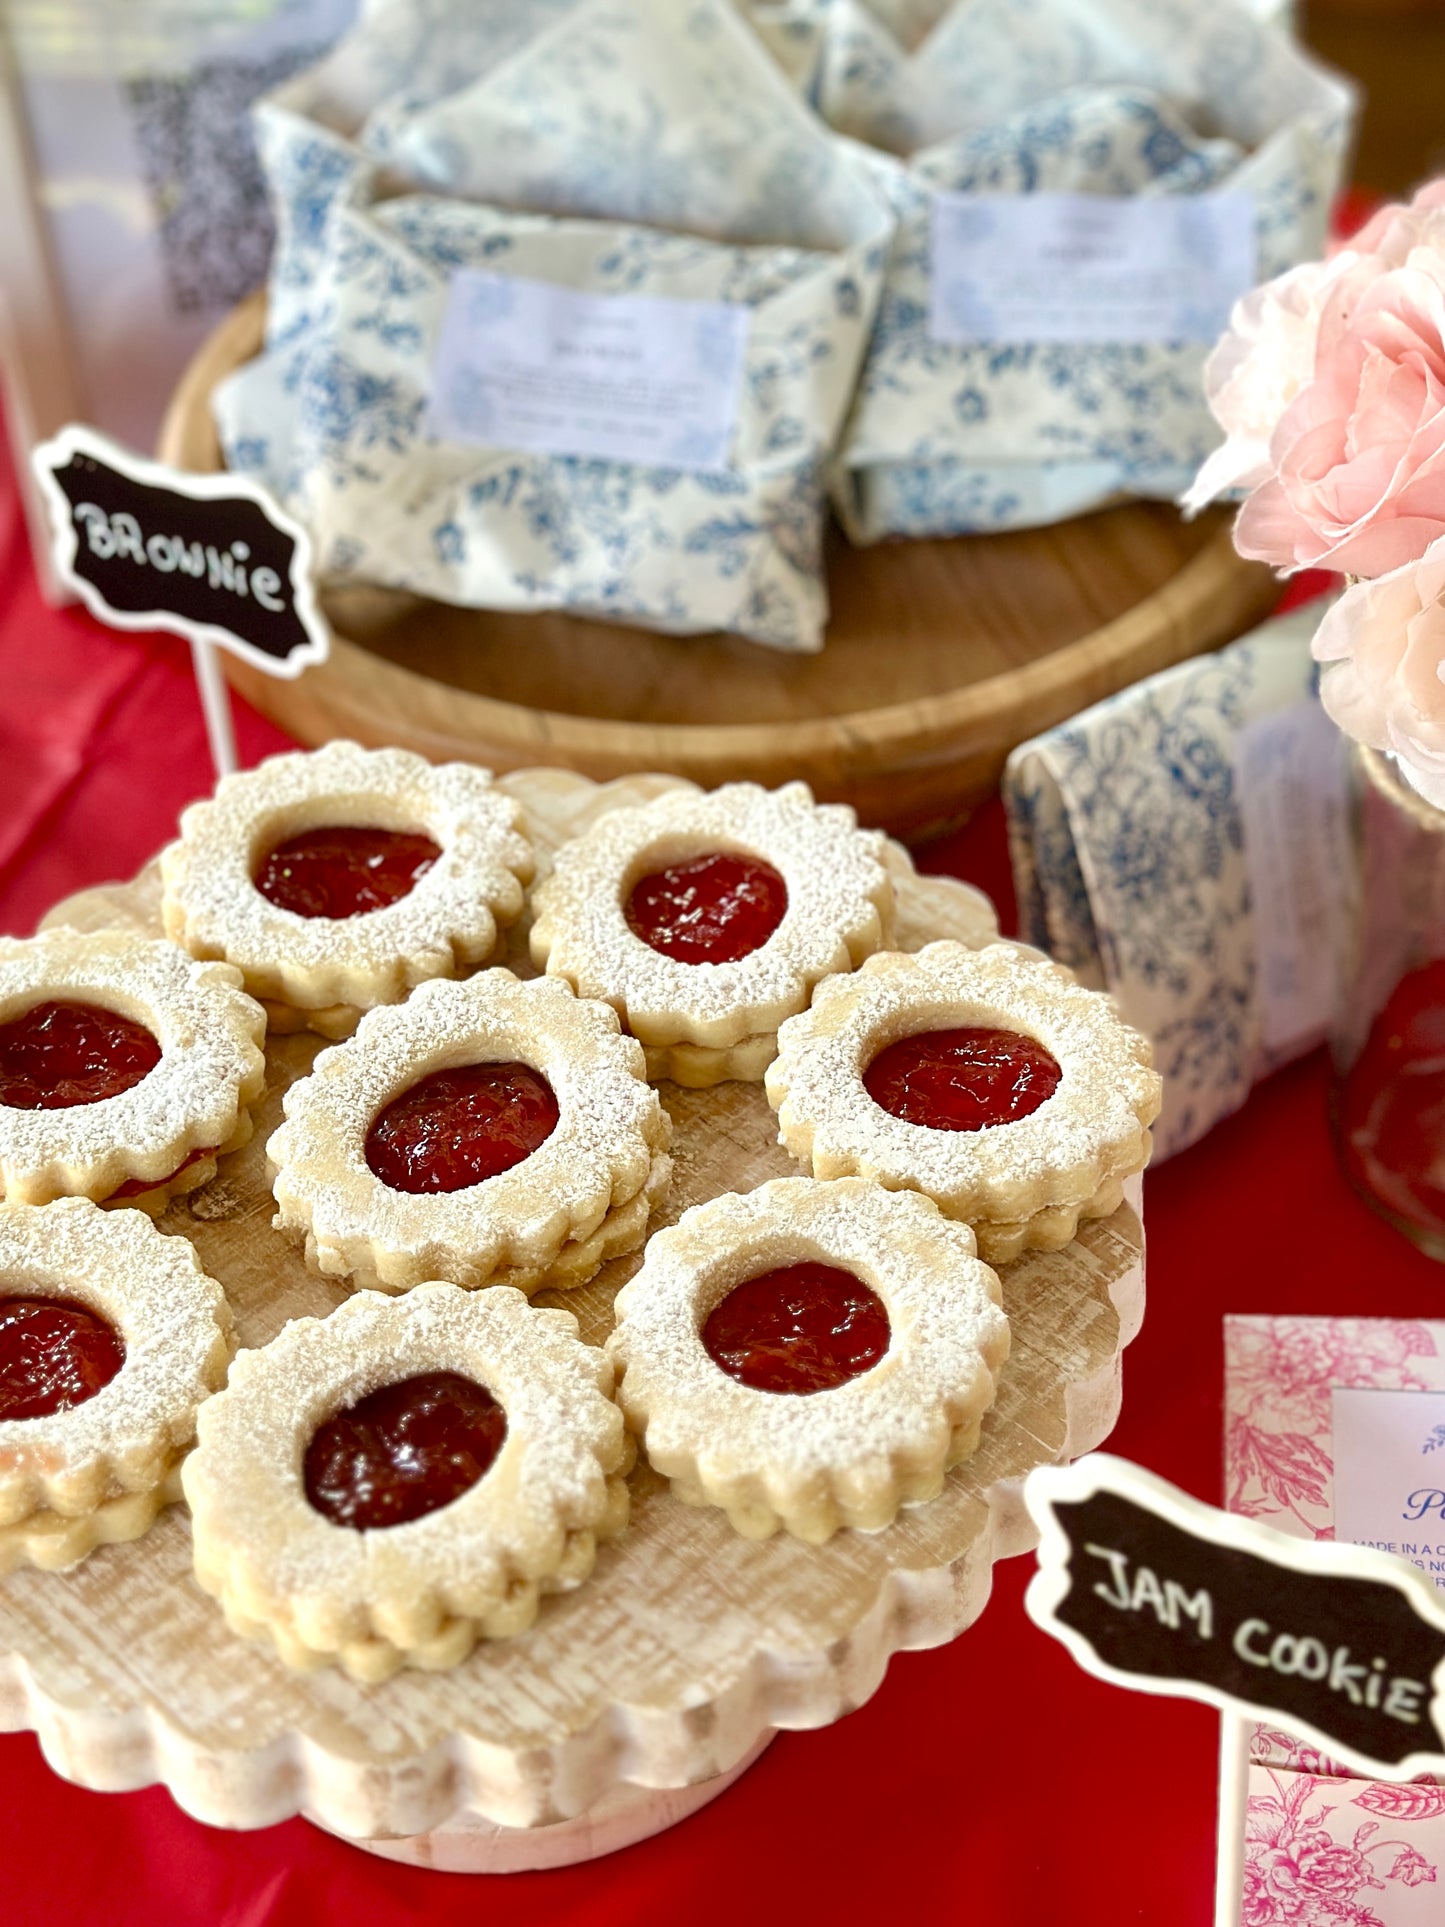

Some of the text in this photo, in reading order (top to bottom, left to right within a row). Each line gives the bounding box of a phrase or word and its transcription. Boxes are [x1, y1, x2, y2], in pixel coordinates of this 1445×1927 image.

[1402, 1543, 1417, 1555] IN
[1421, 1544, 1432, 1555] A
[1085, 1543, 1213, 1640] JAM
